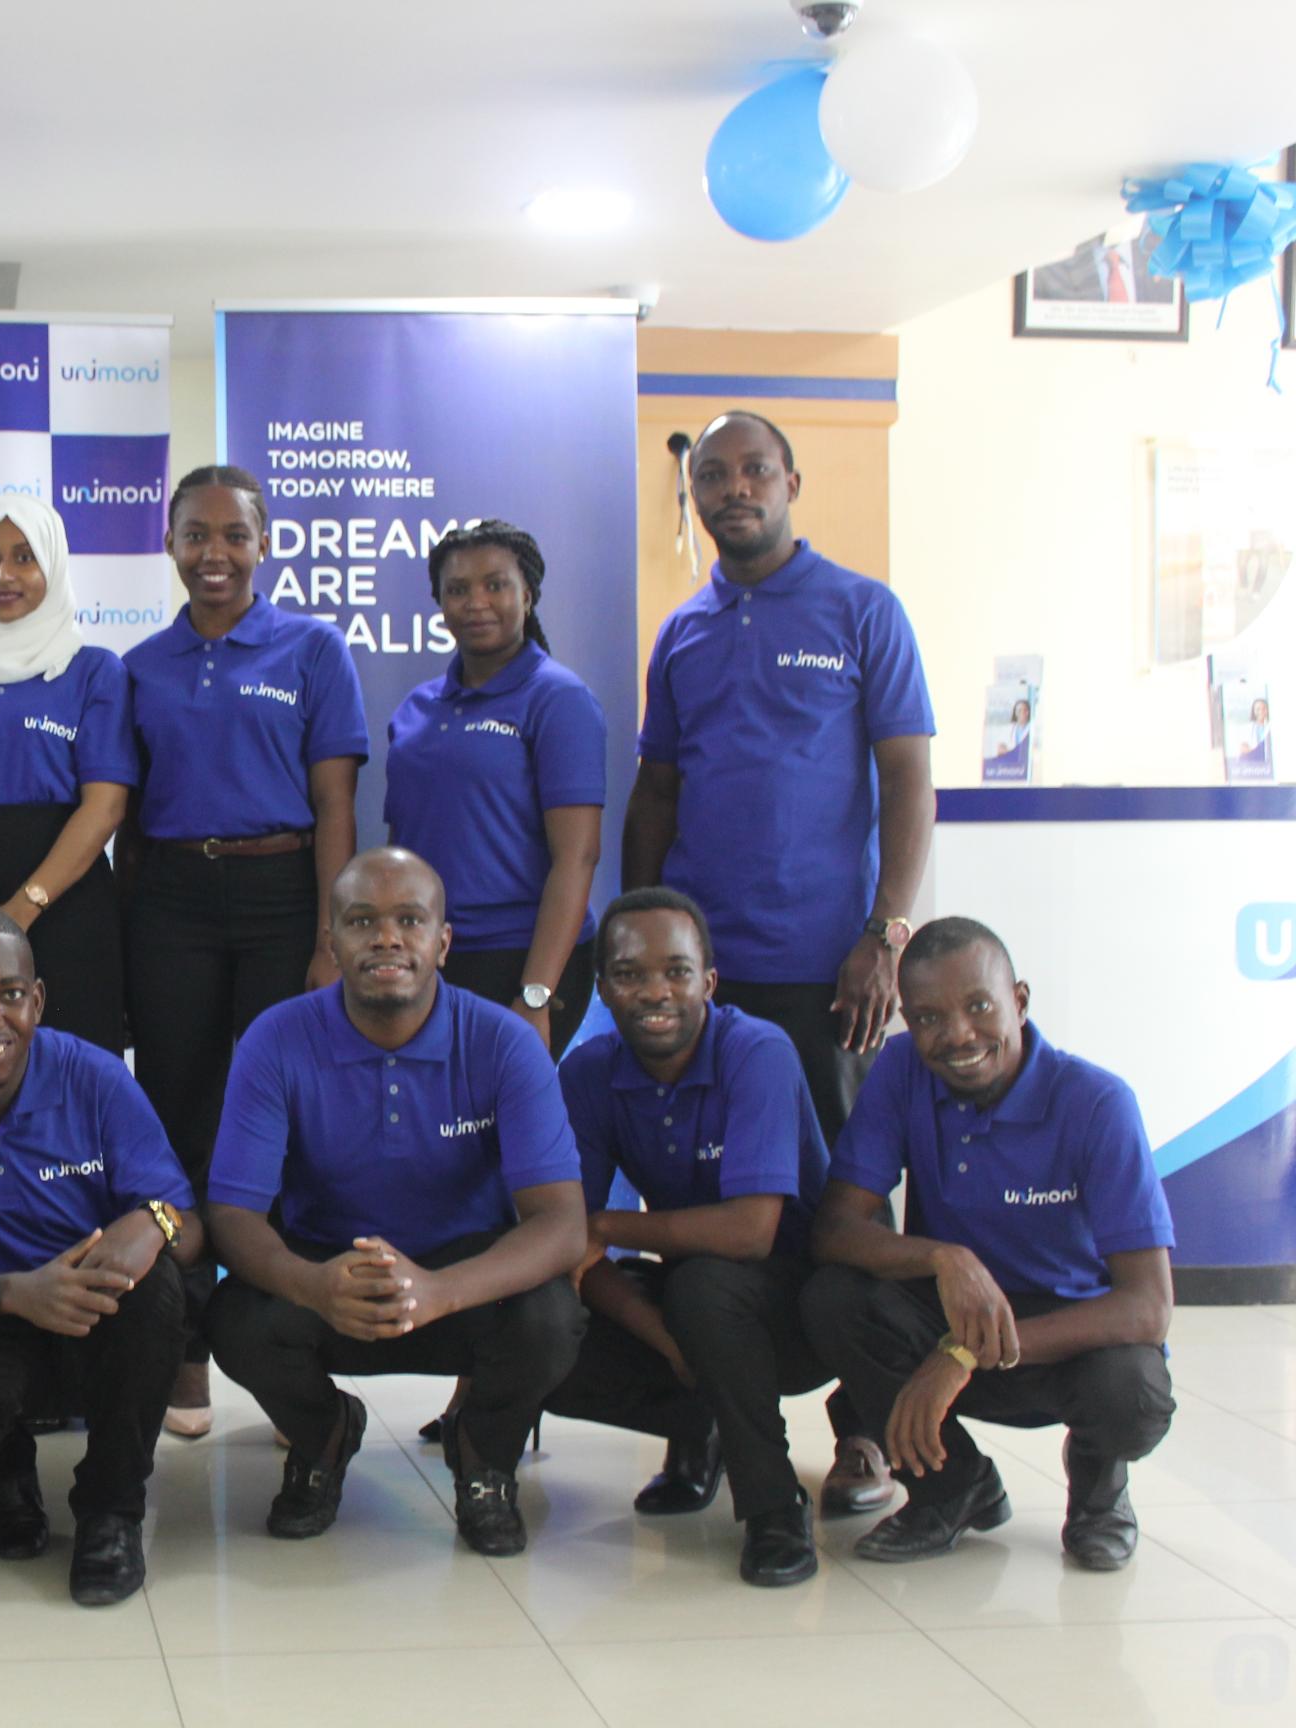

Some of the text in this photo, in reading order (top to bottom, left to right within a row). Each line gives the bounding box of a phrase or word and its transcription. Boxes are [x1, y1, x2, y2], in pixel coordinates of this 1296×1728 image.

[61, 357, 160, 383] unimoni
[268, 421, 364, 441] IMAGINE
[268, 450, 412, 472] TOMORROW,
[62, 478, 162, 503] unimoni
[268, 478, 435, 498] TODAY WHERE
[270, 518, 483, 559] DREAM
[270, 566, 377, 606] ARE
[74, 600, 163, 625] nimoni
[776, 648, 844, 671] unimoni
[240, 682, 297, 705] unimoni
[24, 714, 78, 741] unimoni
[1004, 1182, 1078, 1205] unimoni
